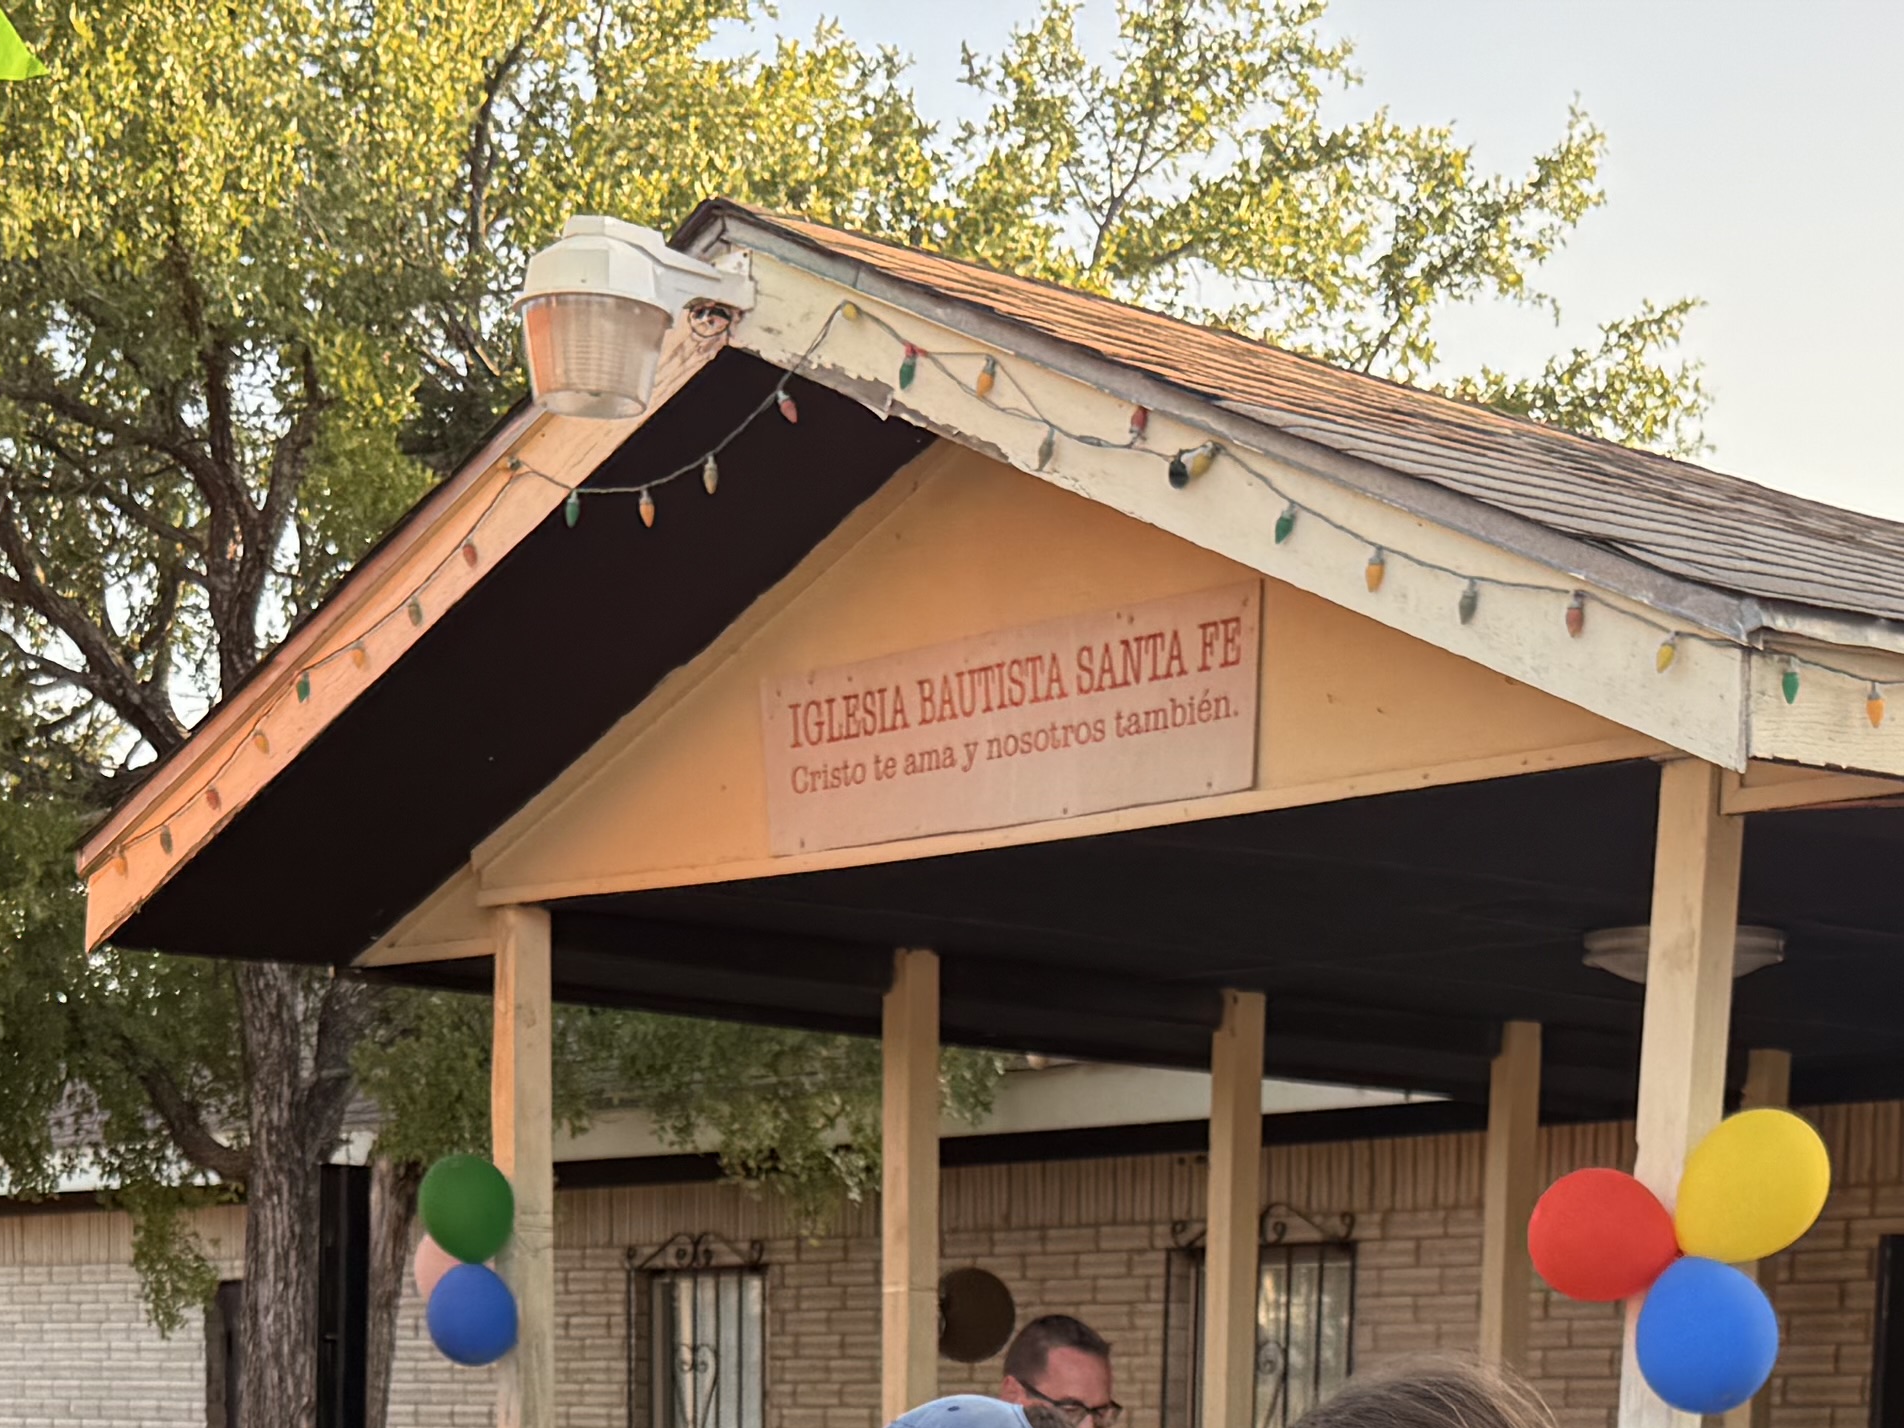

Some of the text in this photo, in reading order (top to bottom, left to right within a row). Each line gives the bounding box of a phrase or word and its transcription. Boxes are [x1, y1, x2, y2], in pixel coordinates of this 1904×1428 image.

[788, 616, 1242, 749] IGLESIA BAUTISTA SANTA FE
[790, 688, 1240, 795] Cristo te ama y nosotros también.
